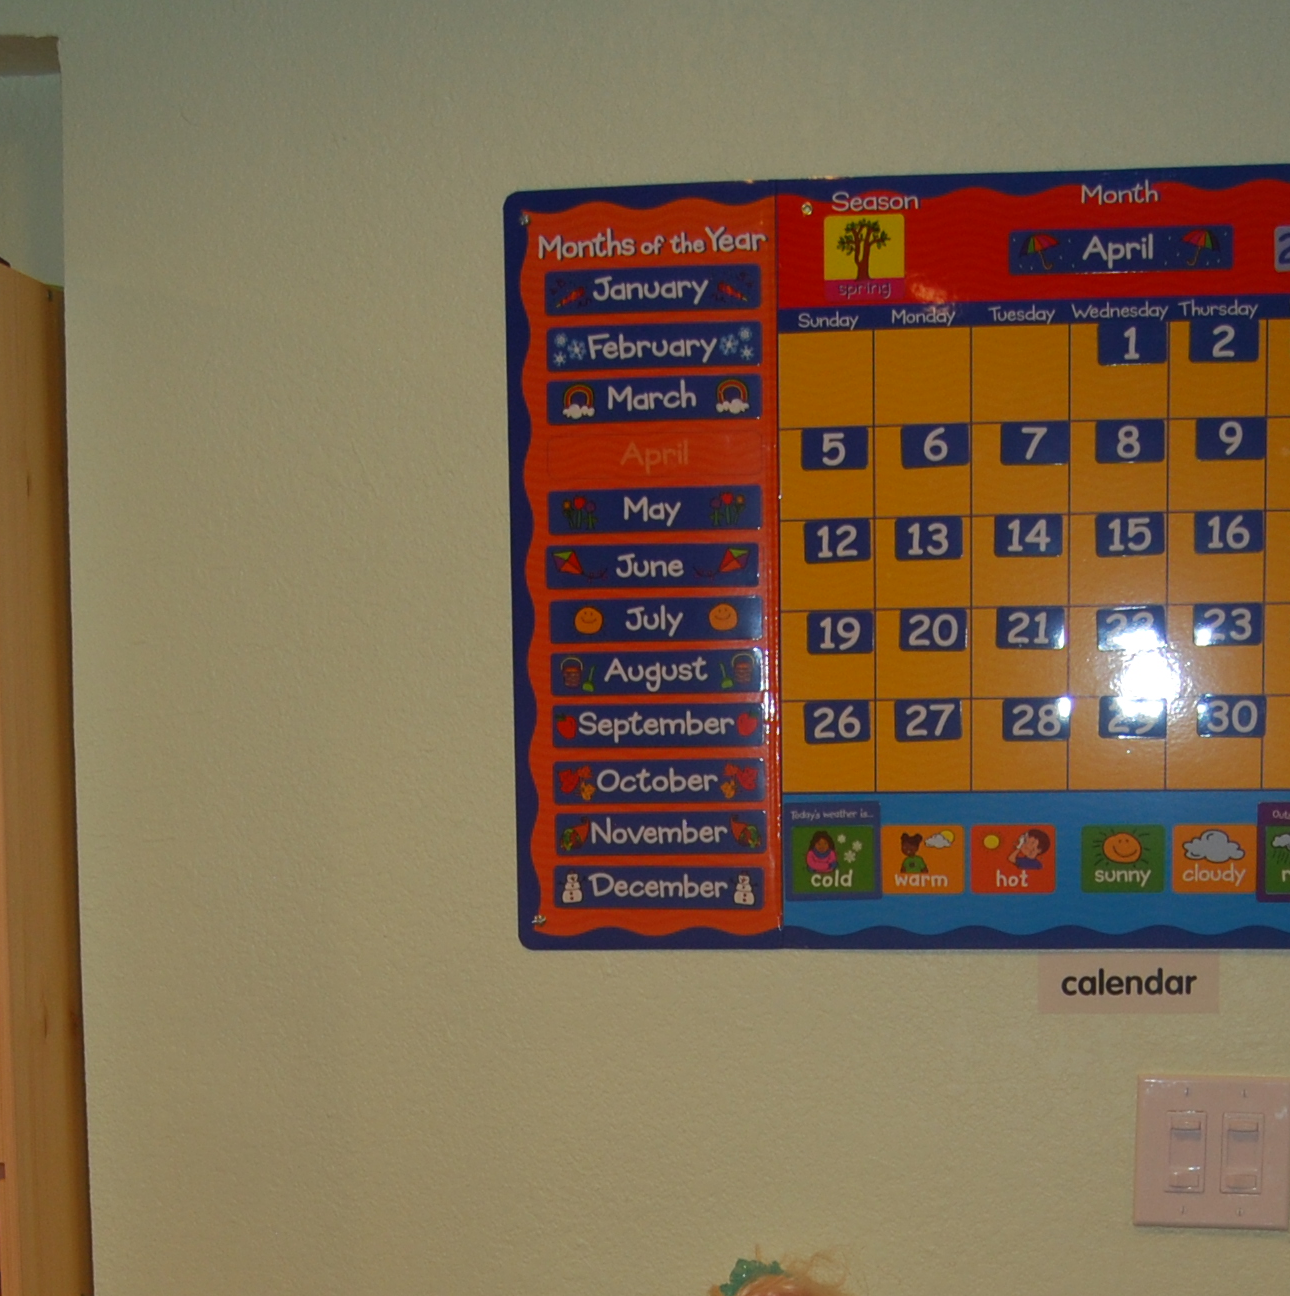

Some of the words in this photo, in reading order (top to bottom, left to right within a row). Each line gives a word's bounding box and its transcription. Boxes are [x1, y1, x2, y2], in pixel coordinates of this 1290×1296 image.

[832, 193, 919, 212] Season
[1081, 180, 1159, 205] Month
[538, 228, 635, 260] Months
[641, 236, 664, 255] of
[671, 232, 705, 253] the
[705, 226, 767, 252] Year
[1083, 235, 1154, 270] April
[593, 276, 709, 304] January
[838, 278, 891, 300] spring
[797, 312, 859, 330] Sunday
[891, 306, 956, 326] Monday
[988, 306, 1055, 324] Tuesday
[1071, 302, 1169, 321] Wednesday
[1179, 300, 1259, 319] Thursday
[587, 332, 717, 362] February
[1123, 327, 1139, 359] 1
[1212, 326, 1235, 358] 2
[608, 379, 696, 410] March
[821, 432, 845, 465] 5
[924, 428, 948, 461] 6
[1022, 428, 1047, 460] 7
[1117, 426, 1140, 458] 8
[1219, 421, 1241, 454] 9
[620, 442, 689, 474] April
[623, 496, 681, 526] May
[817, 525, 857, 558] 12
[908, 522, 949, 556] 13
[1007, 520, 1050, 552] 14
[1109, 519, 1151, 552] 15
[1208, 516, 1249, 548] 16
[616, 554, 684, 578] June
[625, 606, 683, 636] July
[819, 617, 860, 650] 19
[908, 614, 958, 648] 20
[1007, 613, 1047, 646] 21
[1204, 608, 1251, 640] 23
[604, 657, 708, 691] August
[578, 712, 735, 742] September
[813, 706, 861, 738] 26
[905, 704, 955, 736] 27
[1011, 703, 1057, 736] 28
[1207, 700, 1258, 733] 30
[597, 766, 717, 792] October
[791, 810, 820, 821] Today's
[823, 809, 857, 820] weather
[591, 817, 727, 844] November
[587, 873, 727, 898] December
[811, 870, 853, 888] cold
[894, 874, 948, 887] warm
[995, 868, 1029, 890] hot
[1094, 866, 1151, 890] sunny
[1181, 864, 1246, 886] cloudy
[1061, 968, 1197, 996] calendar
